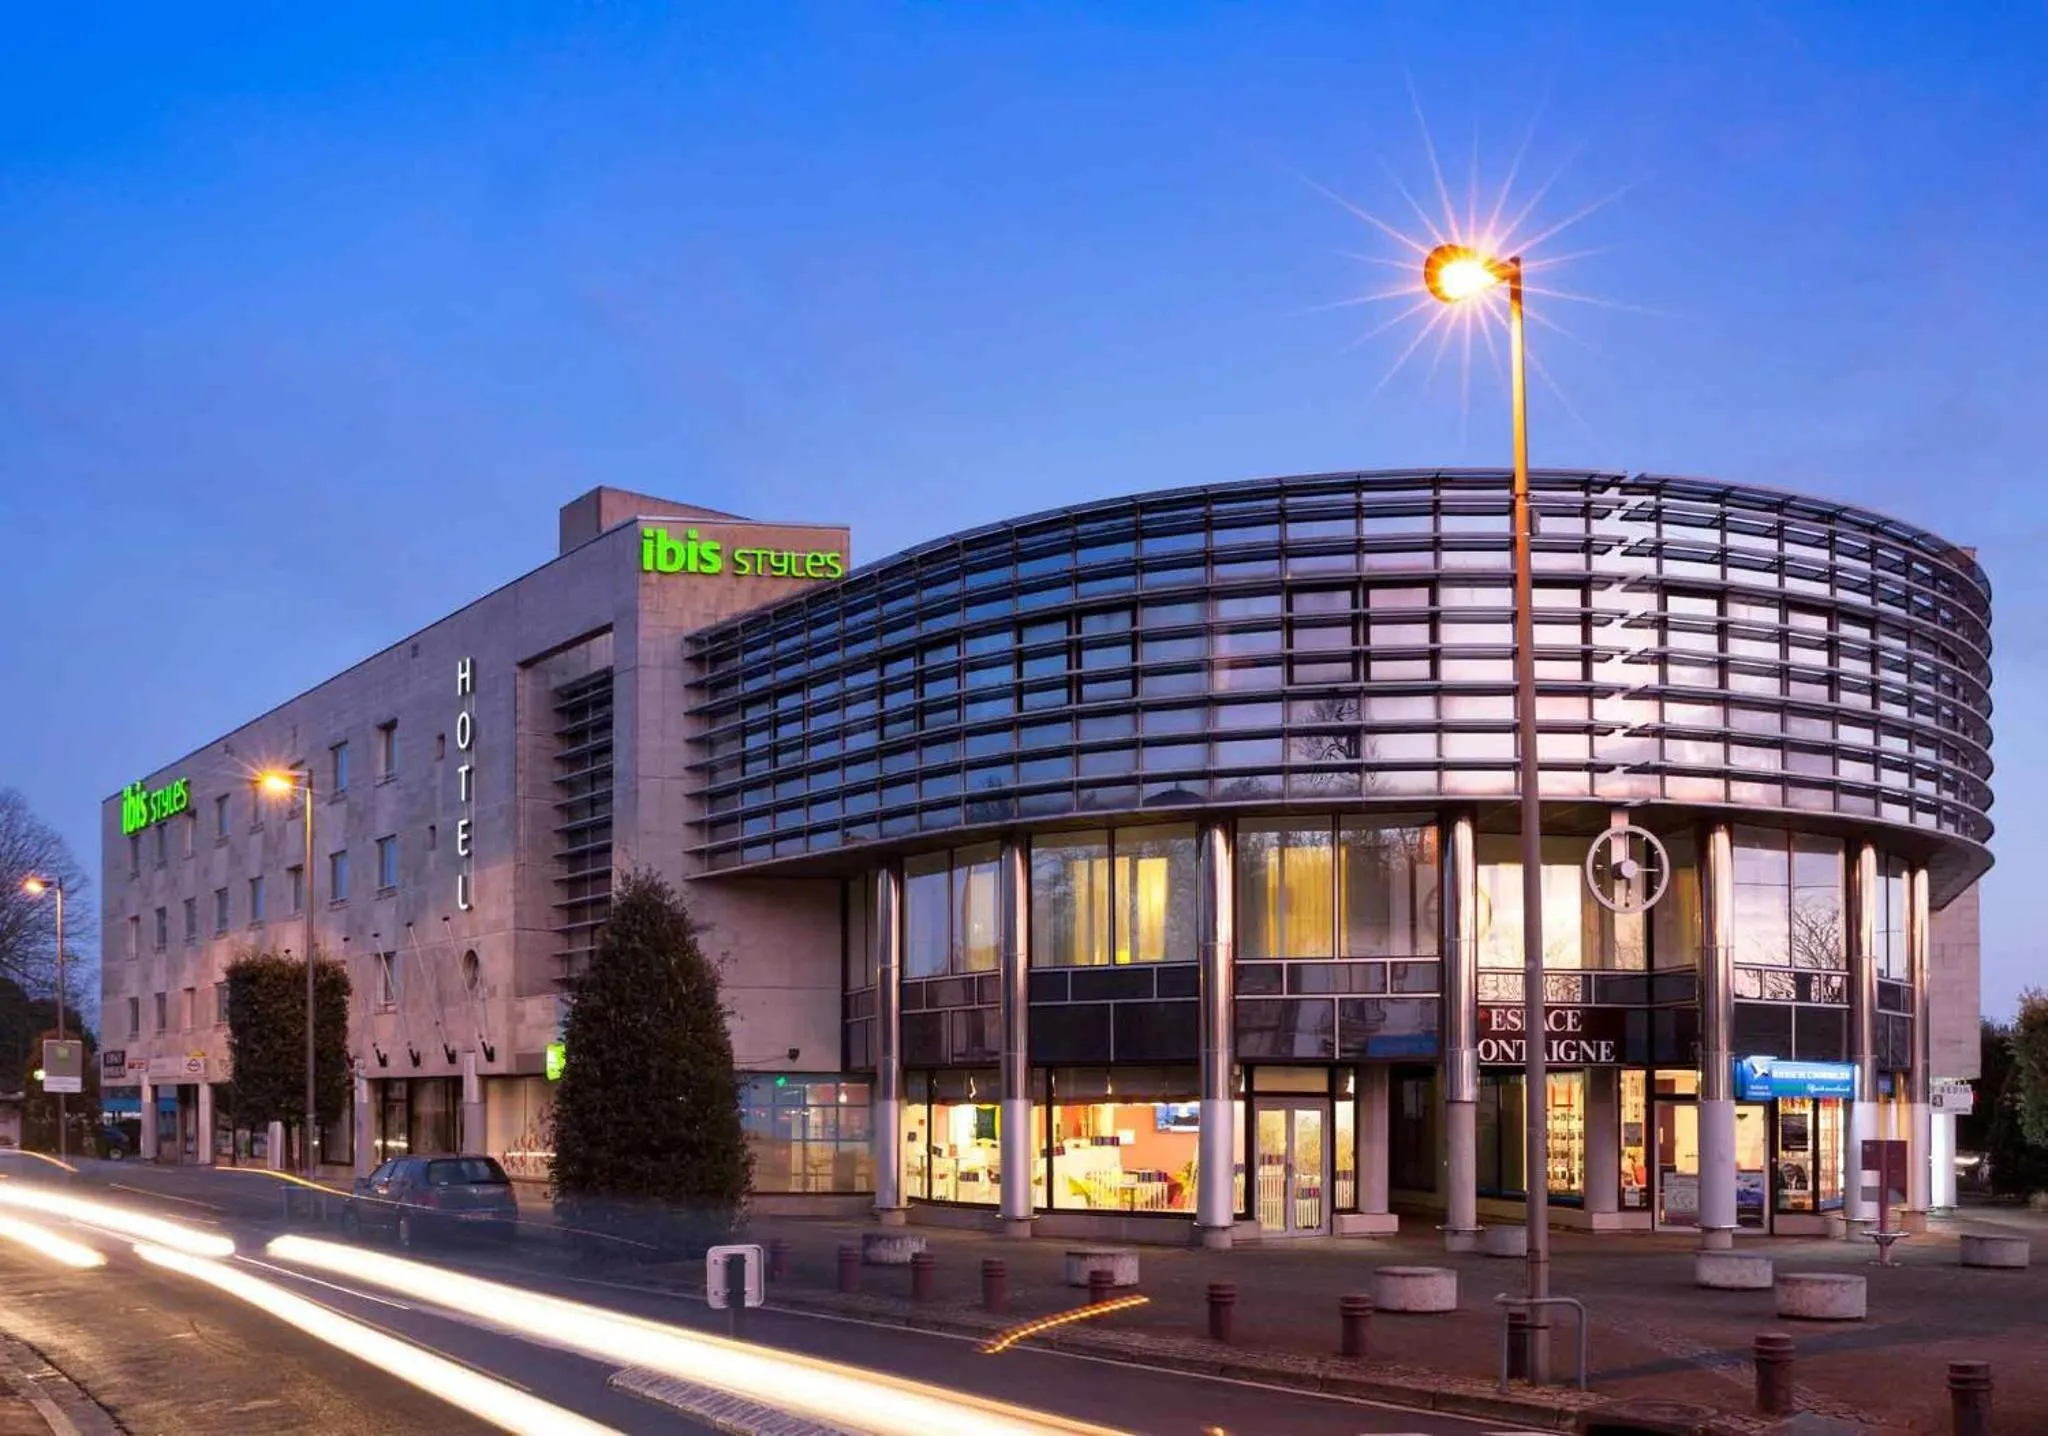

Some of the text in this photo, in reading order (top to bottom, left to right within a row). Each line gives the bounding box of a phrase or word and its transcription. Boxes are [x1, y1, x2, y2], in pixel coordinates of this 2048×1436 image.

[642, 528, 722, 574] ibis
[123, 781, 147, 835] ibis
[457, 657, 471, 911] HOTEL
[1490, 1008, 1582, 1032] ESCE
